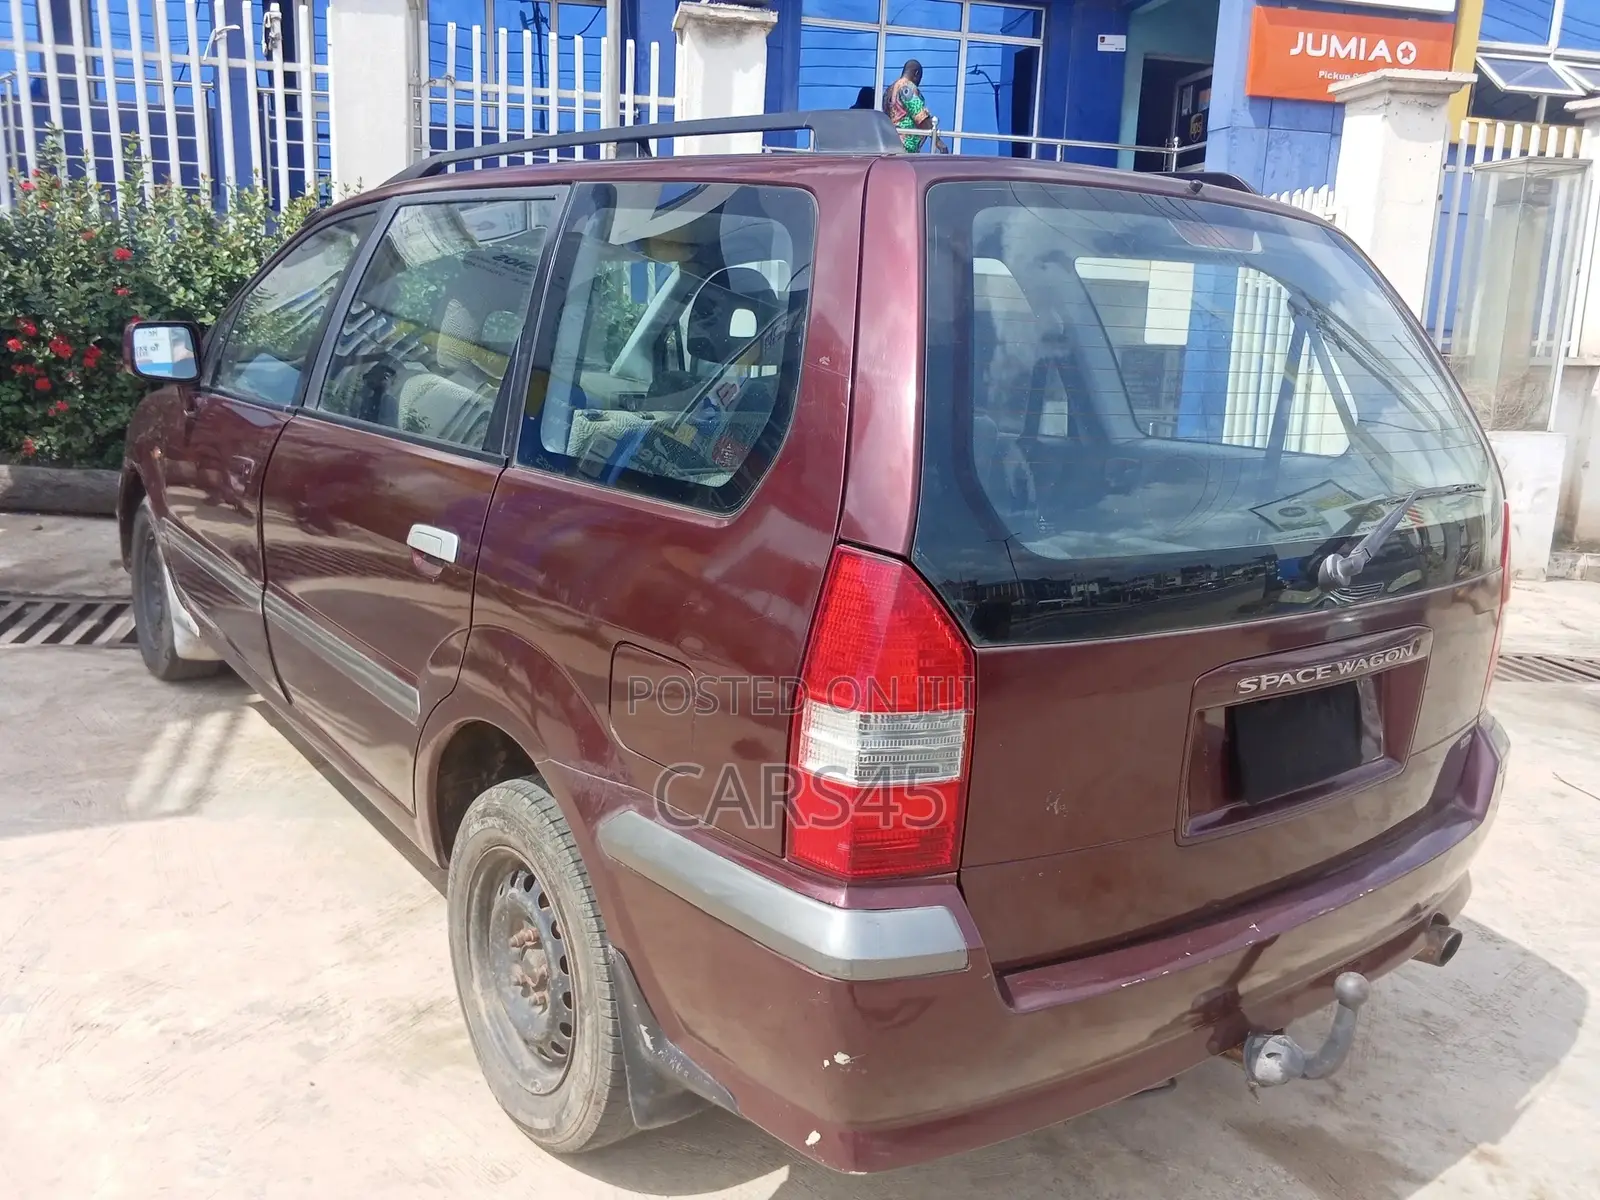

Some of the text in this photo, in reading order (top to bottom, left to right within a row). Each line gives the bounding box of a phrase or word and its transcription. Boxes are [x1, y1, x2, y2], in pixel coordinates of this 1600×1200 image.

[1289, 31, 1393, 63] JUMIA
[1238, 645, 1416, 694] SPACE WAGON
